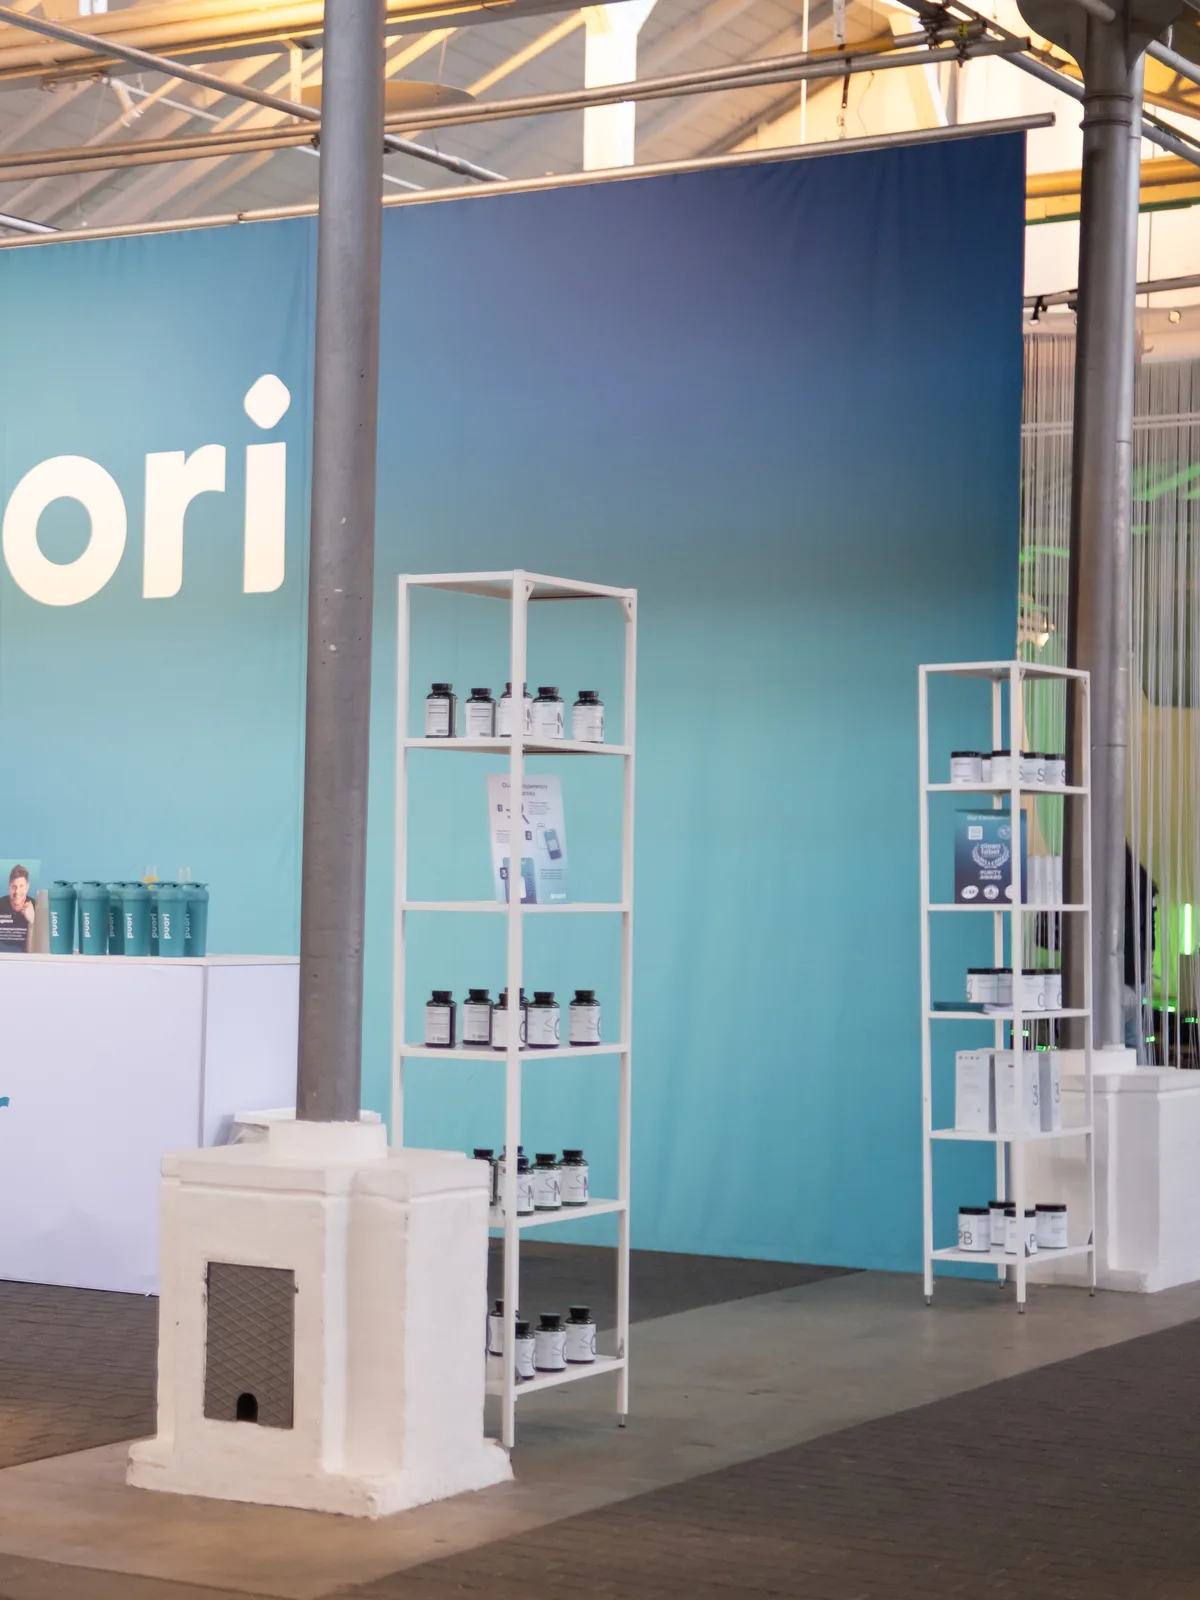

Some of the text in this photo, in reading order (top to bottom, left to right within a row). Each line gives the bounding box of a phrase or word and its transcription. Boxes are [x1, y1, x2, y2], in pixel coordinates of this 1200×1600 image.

[50, 911, 60, 938] puori
[83, 912, 92, 938] puori
[125, 913, 135, 939] puori
[162, 913, 172, 940] puori
